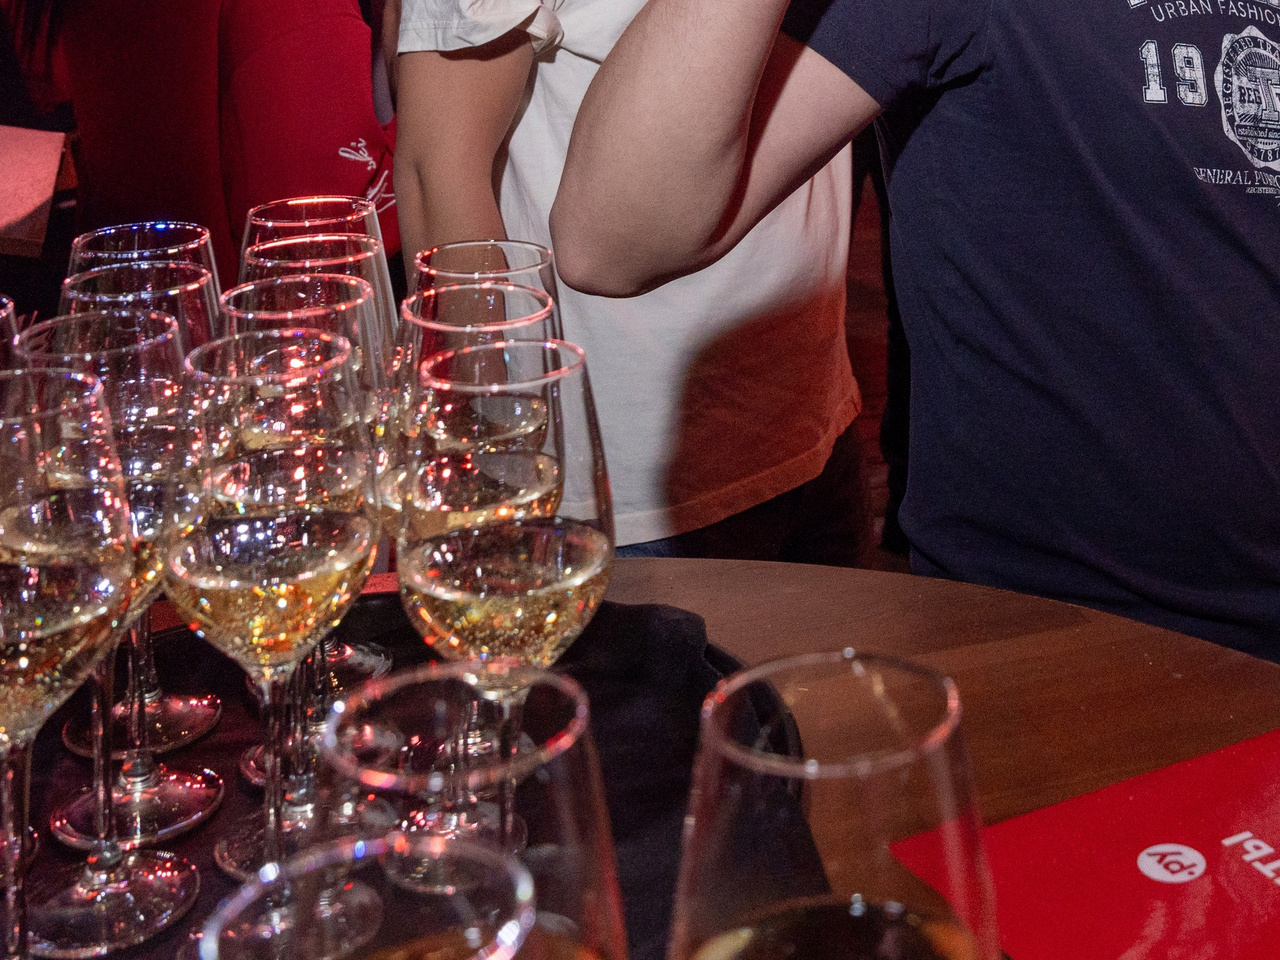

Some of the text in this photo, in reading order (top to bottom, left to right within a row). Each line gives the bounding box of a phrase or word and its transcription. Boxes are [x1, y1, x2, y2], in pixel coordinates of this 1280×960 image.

[1150, 0, 1214, 22] URBAN
[1138, 40, 1209, 108] 19
[1222, 37, 1254, 117] REGISTERED
[1237, 126, 1268, 139] established
